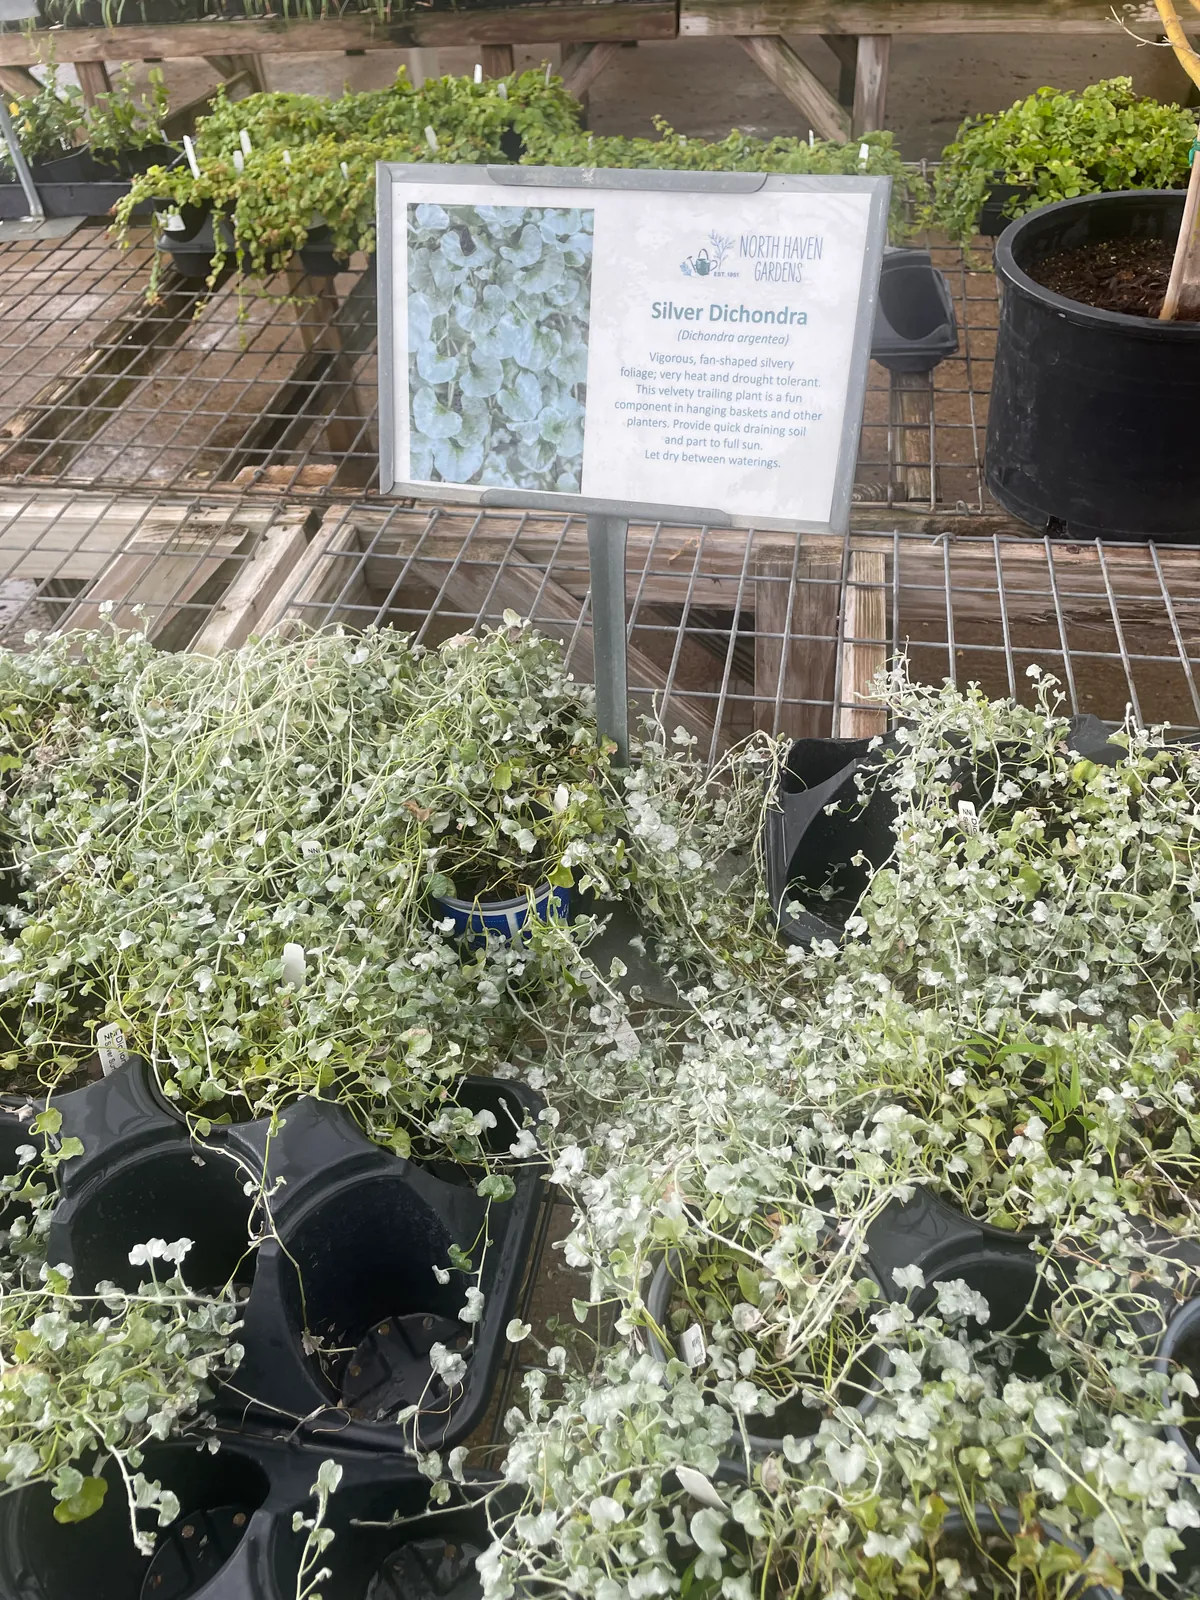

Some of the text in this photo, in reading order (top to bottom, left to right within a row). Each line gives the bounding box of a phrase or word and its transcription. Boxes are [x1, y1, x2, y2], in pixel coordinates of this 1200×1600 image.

[739, 235, 823, 260] NORTH HAVEN
[754, 261, 802, 282] GARDENS
[651, 302, 807, 325] Silver Dichondra
[677, 330, 789, 346] (Dichondra argentea)
[649, 352, 794, 370] Vigorous, fan-shaped silvery
[620, 367, 820, 387] foliage; very heat and drought tolerant.
[636, 384, 656, 394] This
[659, 386, 694, 398] velvety
[697, 388, 732, 401] trailing
[736, 390, 762, 403] plant
[765, 393, 773, 401] is
[785, 393, 802, 403] fun
[614, 401, 822, 421] component in hanging baskets and other
[627, 417, 806, 437] planters. Provide quick draining soil
[665, 436, 763, 450] and part to full sun.
[645, 450, 780, 469] Let dry between waterings.
